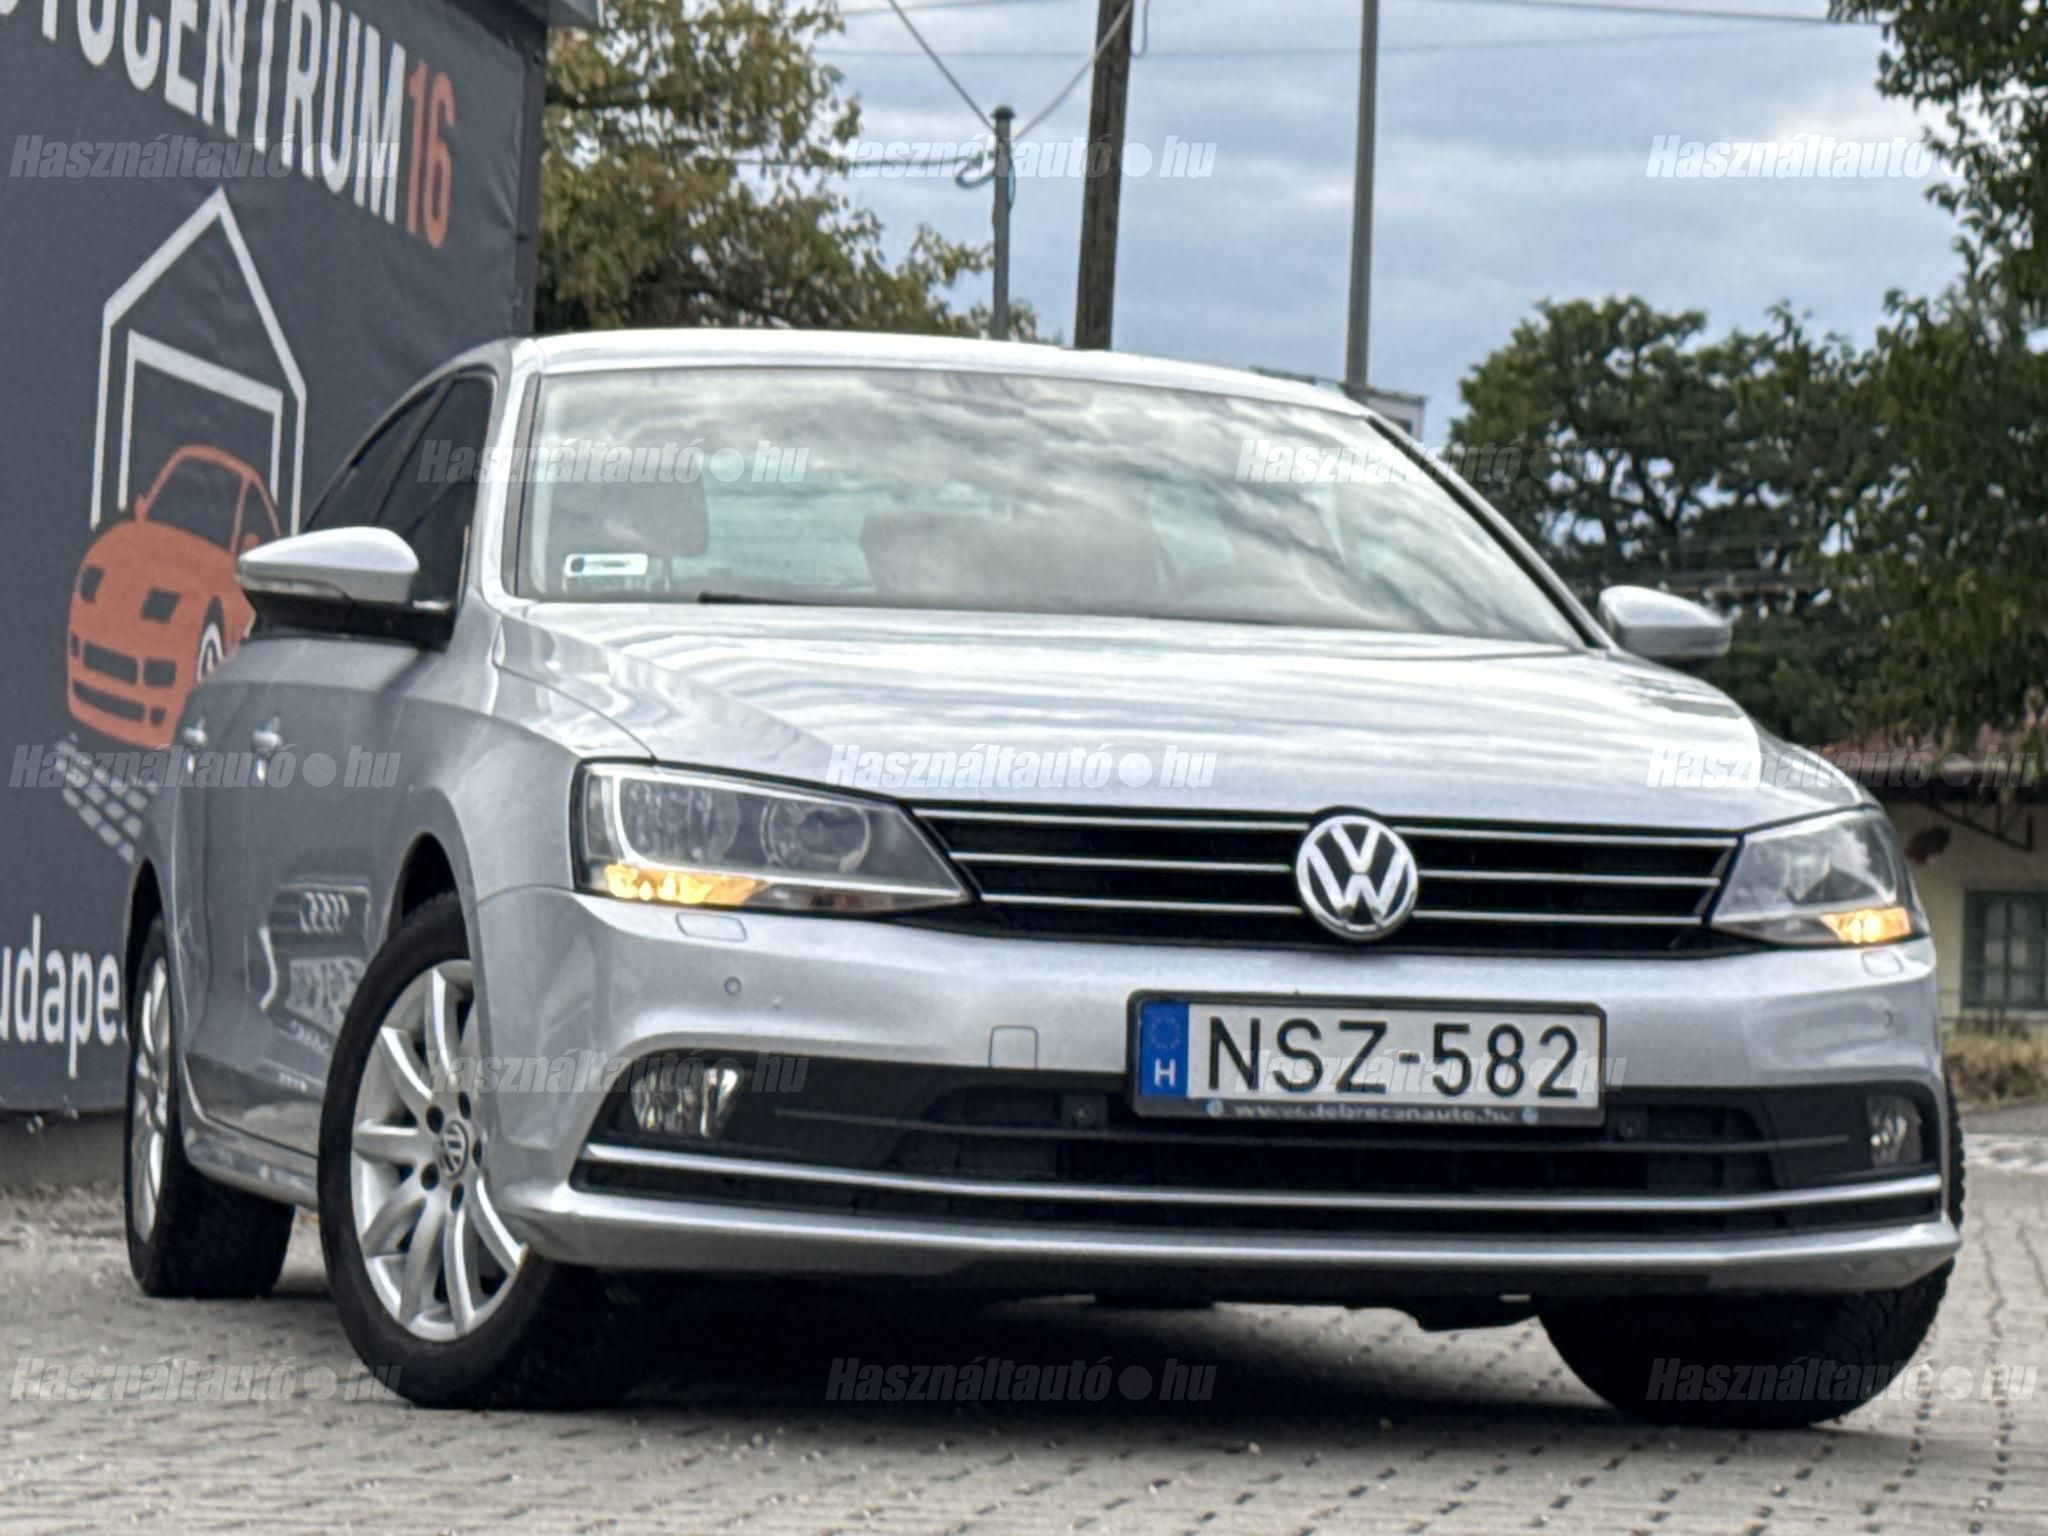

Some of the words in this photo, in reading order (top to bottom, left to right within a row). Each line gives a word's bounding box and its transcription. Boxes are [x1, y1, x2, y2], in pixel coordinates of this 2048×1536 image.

[0, 913, 128, 1079] dape
[1154, 1058, 1177, 1088] H
[1208, 1016, 1578, 1099] NSZ-582
